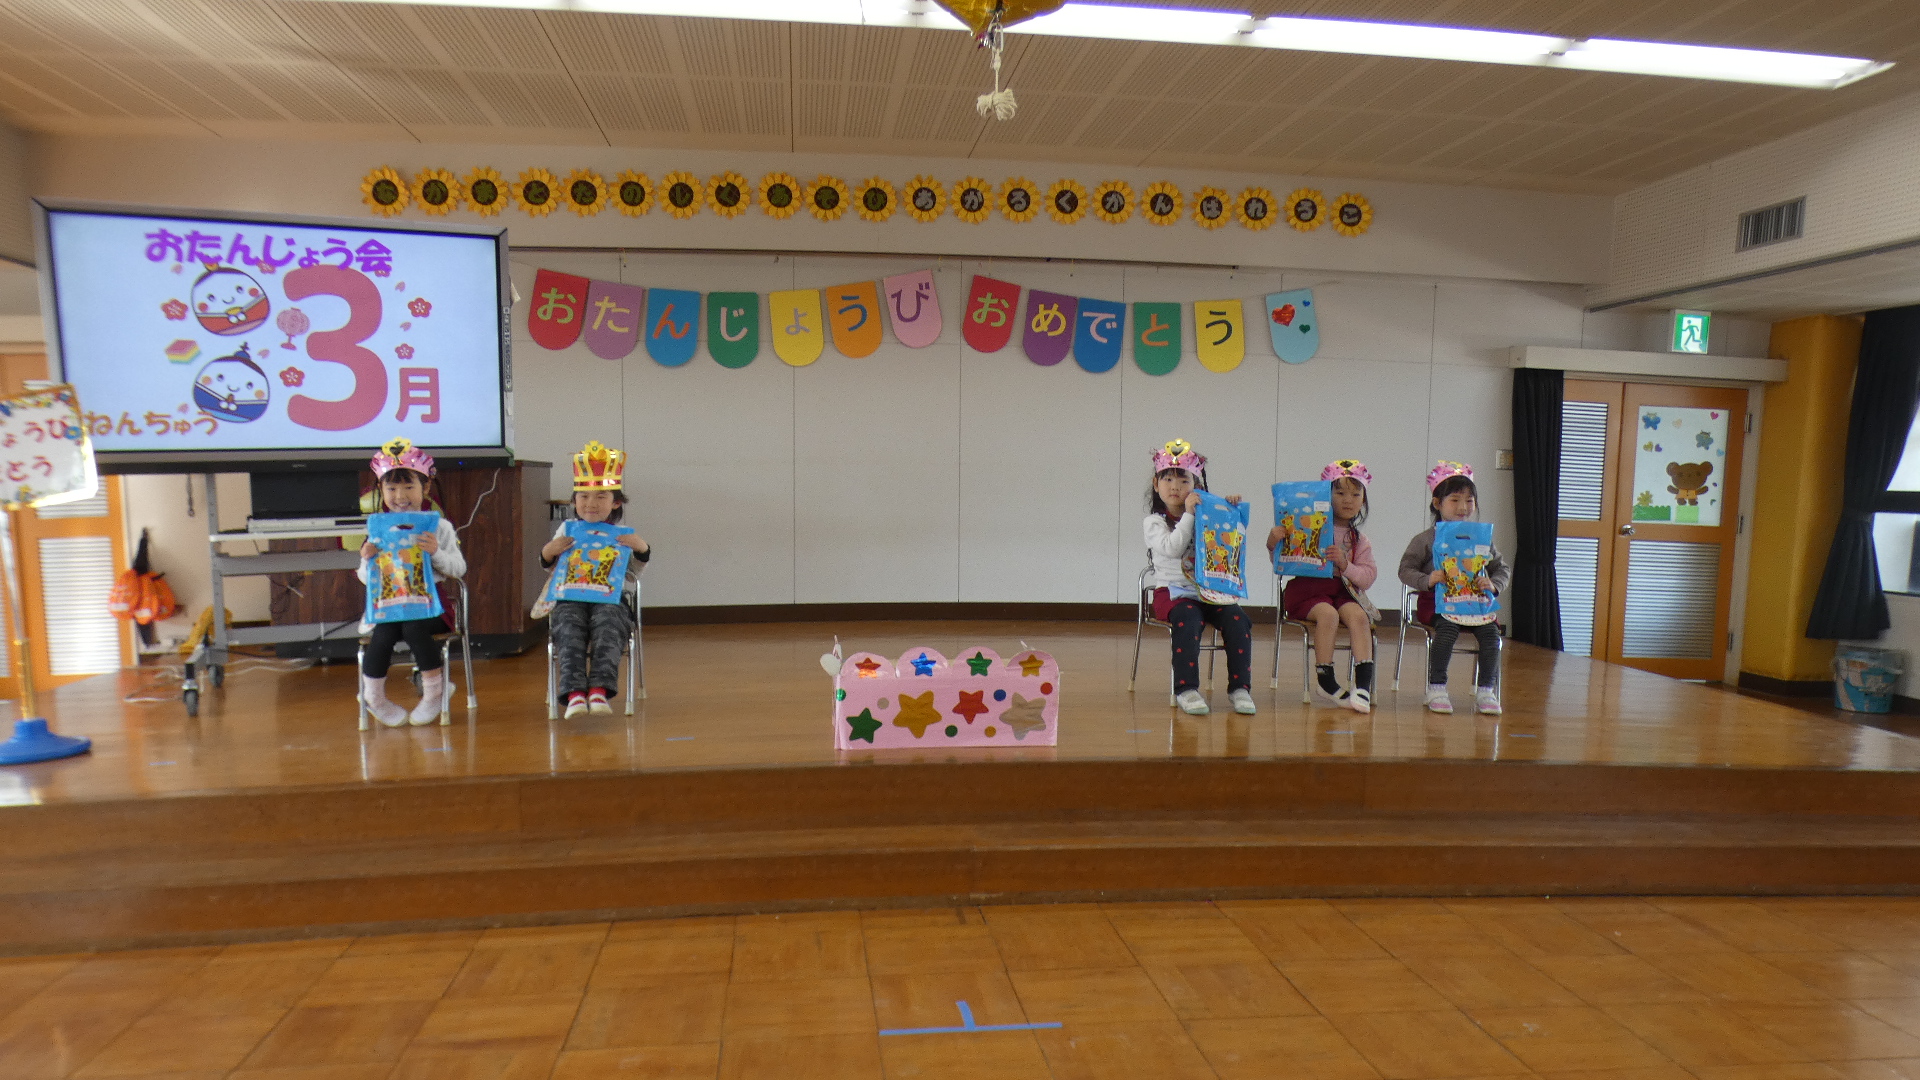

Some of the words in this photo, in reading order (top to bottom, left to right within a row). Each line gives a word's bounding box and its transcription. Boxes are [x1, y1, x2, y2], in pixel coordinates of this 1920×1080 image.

[145, 228, 393, 272] おたんじょう会
[536, 281, 930, 343] おたんじょうび
[972, 291, 1234, 347] おめでとう
[0, 455, 54, 482] とう
